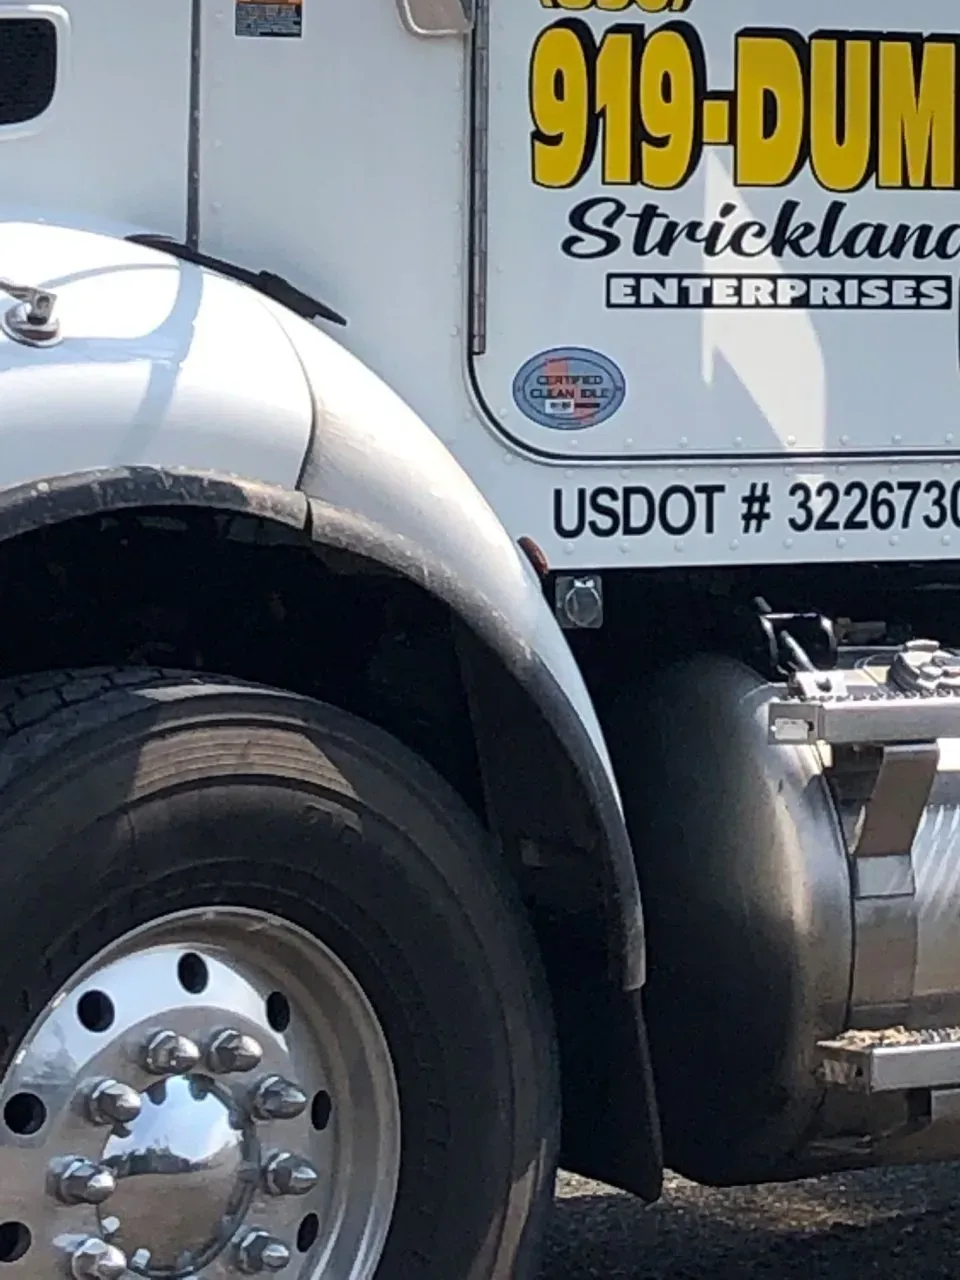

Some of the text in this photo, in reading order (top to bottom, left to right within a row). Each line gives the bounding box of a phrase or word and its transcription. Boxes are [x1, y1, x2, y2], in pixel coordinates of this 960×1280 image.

[610, 277, 949, 308] ENTERPRISES
[536, 375, 603, 385] CERTIFIED
[530, 389, 610, 399] CLEAN IDLE
[554, 485, 725, 539] USDOT
[741, 482, 771, 534] #
